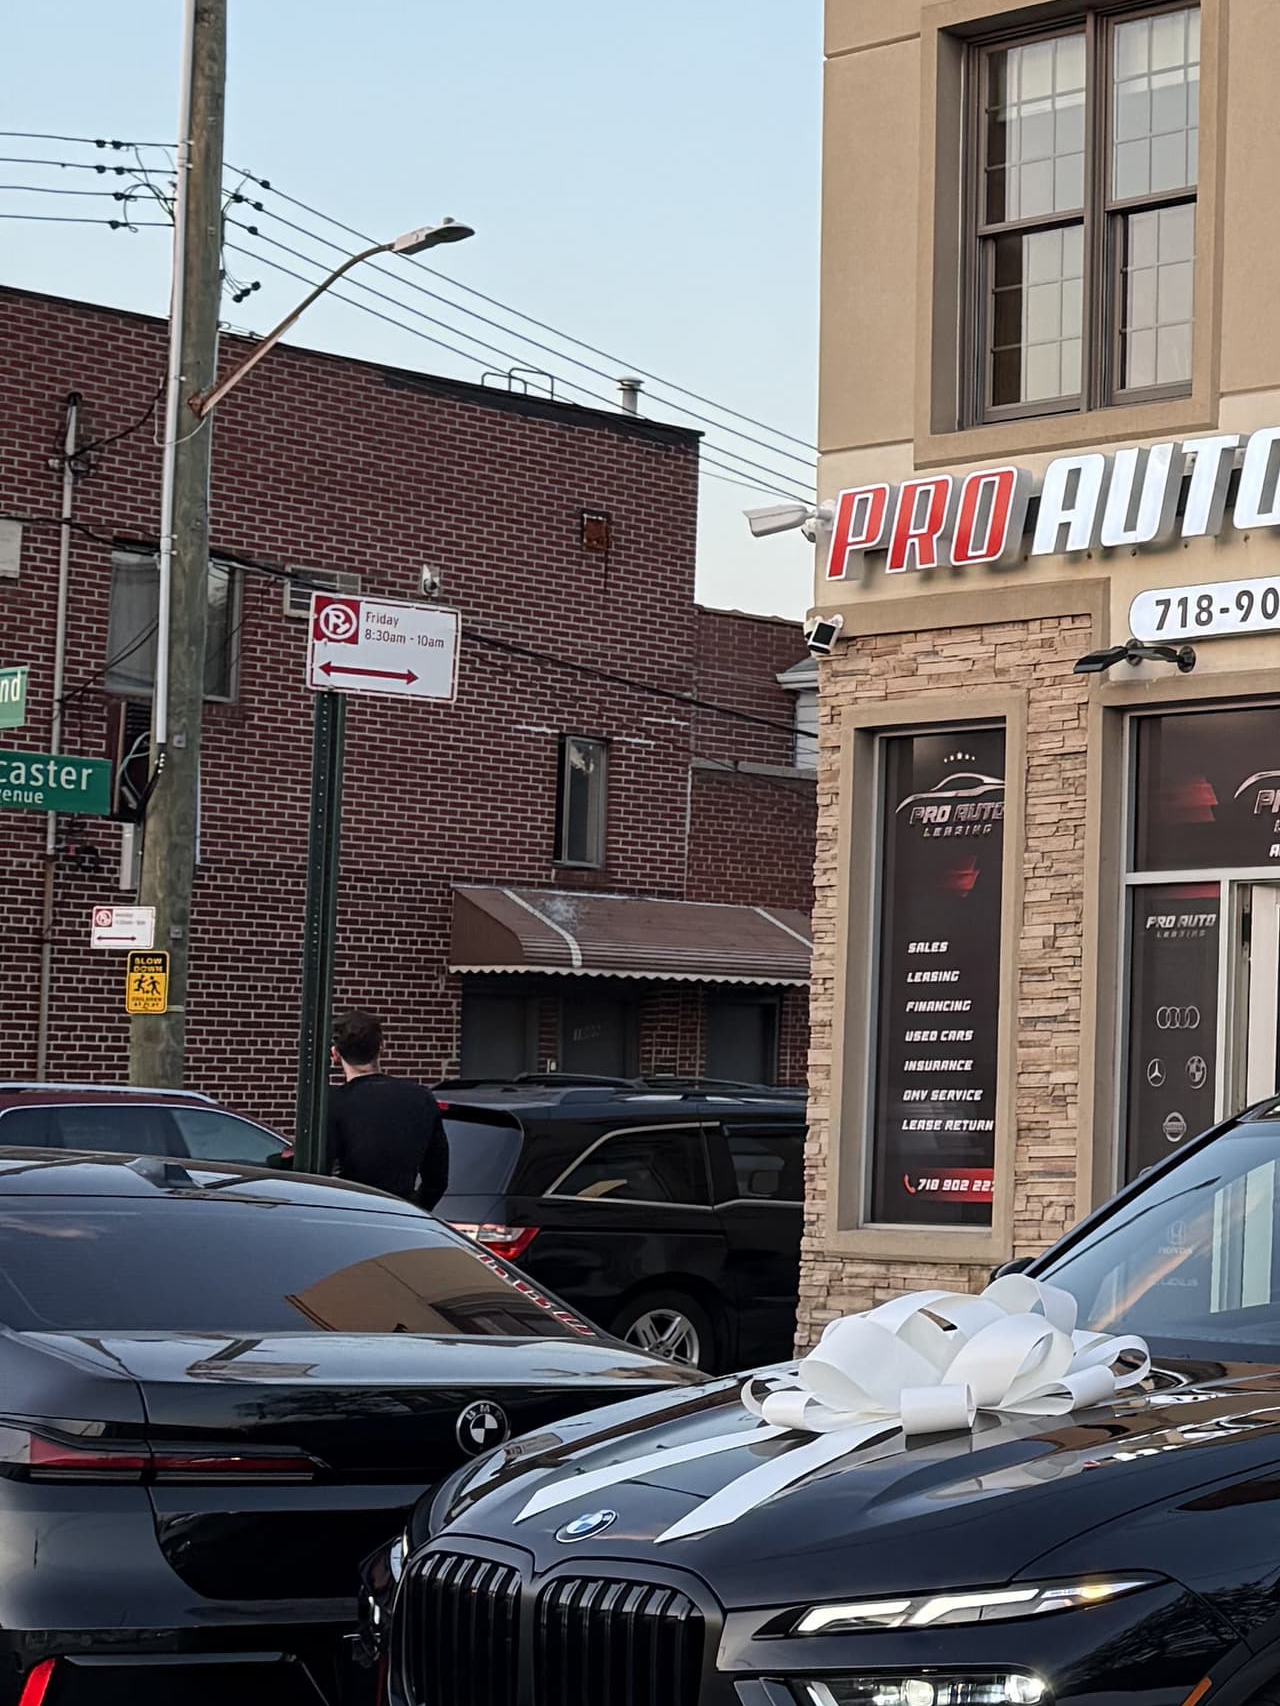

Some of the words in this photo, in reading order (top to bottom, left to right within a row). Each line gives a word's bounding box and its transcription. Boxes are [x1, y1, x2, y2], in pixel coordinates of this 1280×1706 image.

[826, 465, 1024, 582] PRO
[365, 611, 400, 627] Friday
[364, 629, 406, 644] 8:30am
[417, 634, 445, 649] 10am
[0, 788, 44, 805] enue
[909, 803, 952, 825] PRO
[923, 823, 993, 838] LEASING
[1145, 915, 1176, 929] PRO
[1177, 914, 1217, 928] AUTO
[907, 941, 949, 954] SALES
[906, 970, 960, 983] LEASING
[905, 999, 973, 1013] FINANCING
[904, 1030, 937, 1042] USED
[940, 1029, 974, 1042] CARS
[903, 1059, 974, 1072] INSURANCE
[902, 1089, 928, 1102] DMV
[930, 1089, 983, 1102] SERVICE
[901, 1119, 943, 1131] LEASE
[945, 1119, 995, 1131] RETURN
[917, 1178, 939, 1191] 718
[942, 1179, 969, 1192] 902
[972, 1180, 994, 1192] 22
